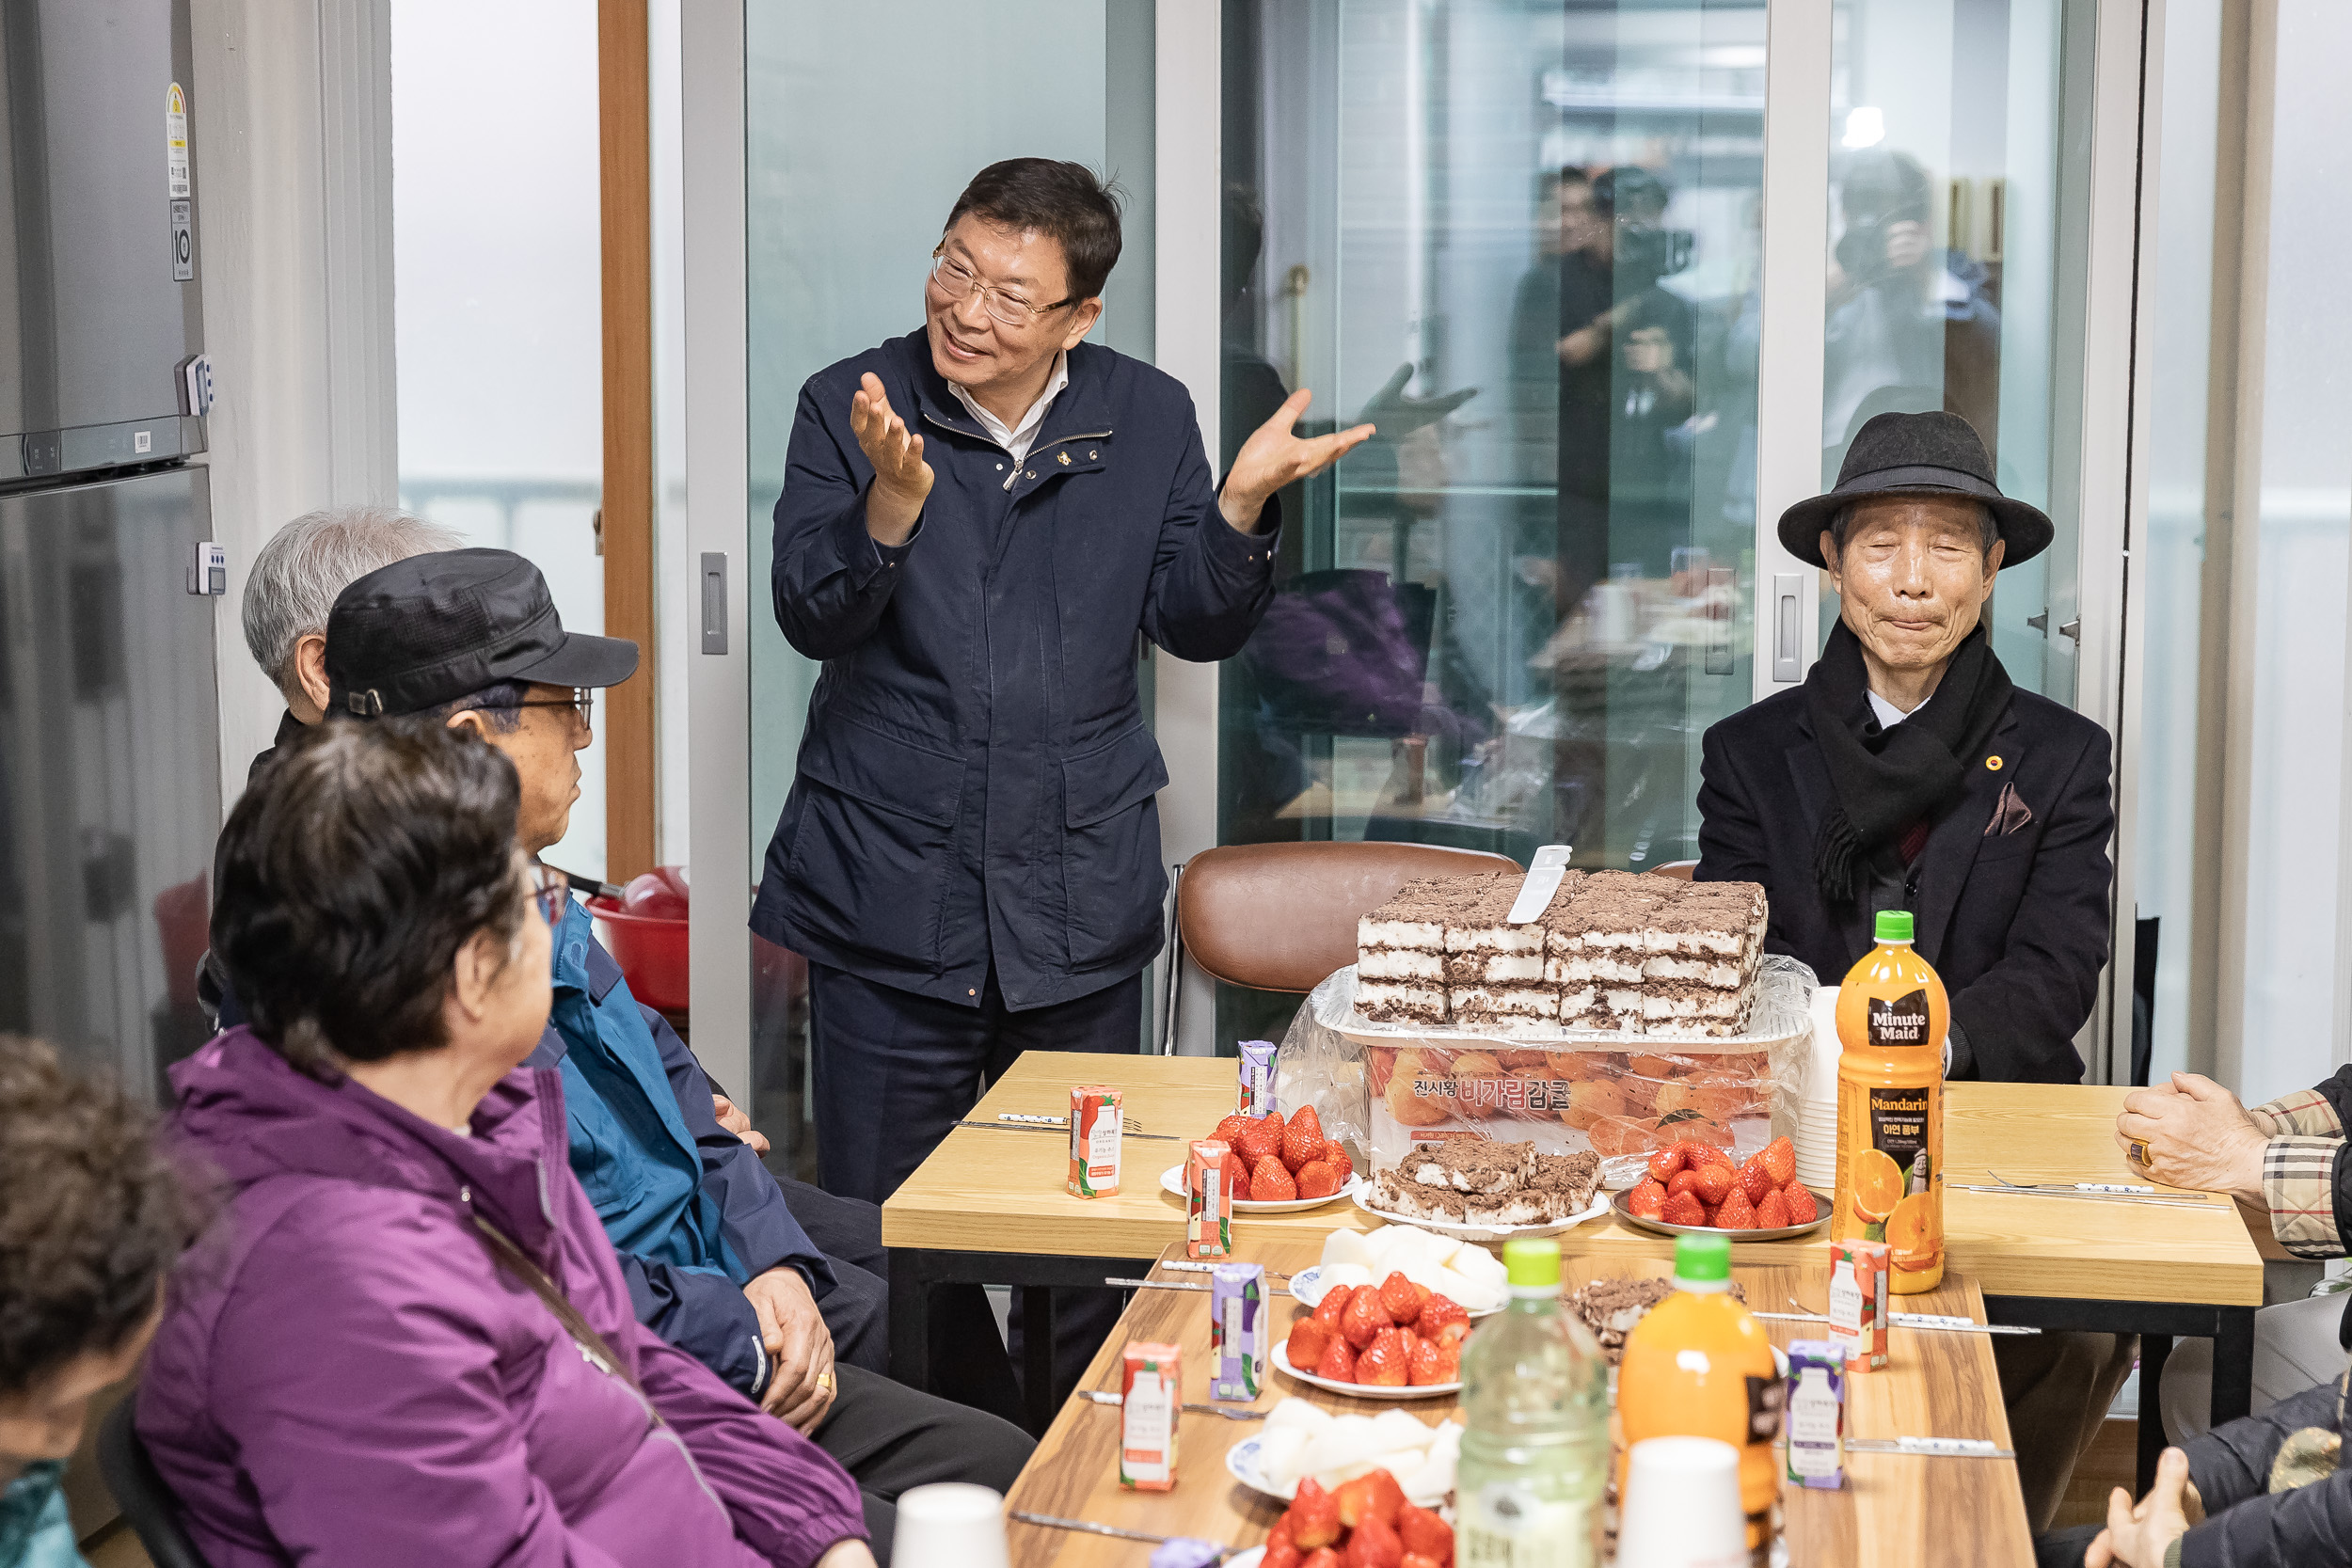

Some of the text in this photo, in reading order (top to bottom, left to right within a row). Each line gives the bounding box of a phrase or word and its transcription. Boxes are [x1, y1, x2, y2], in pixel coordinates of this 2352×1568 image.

[175, 230, 190, 263] 10
[1872, 1012, 1926, 1026] Minute
[1880, 1026, 1918, 1040] Maid
[1413, 1080, 1458, 1098] 진시황
[1871, 1098, 1928, 1111] Mandarin
[1883, 1123, 1919, 1136] 아연 풍부
